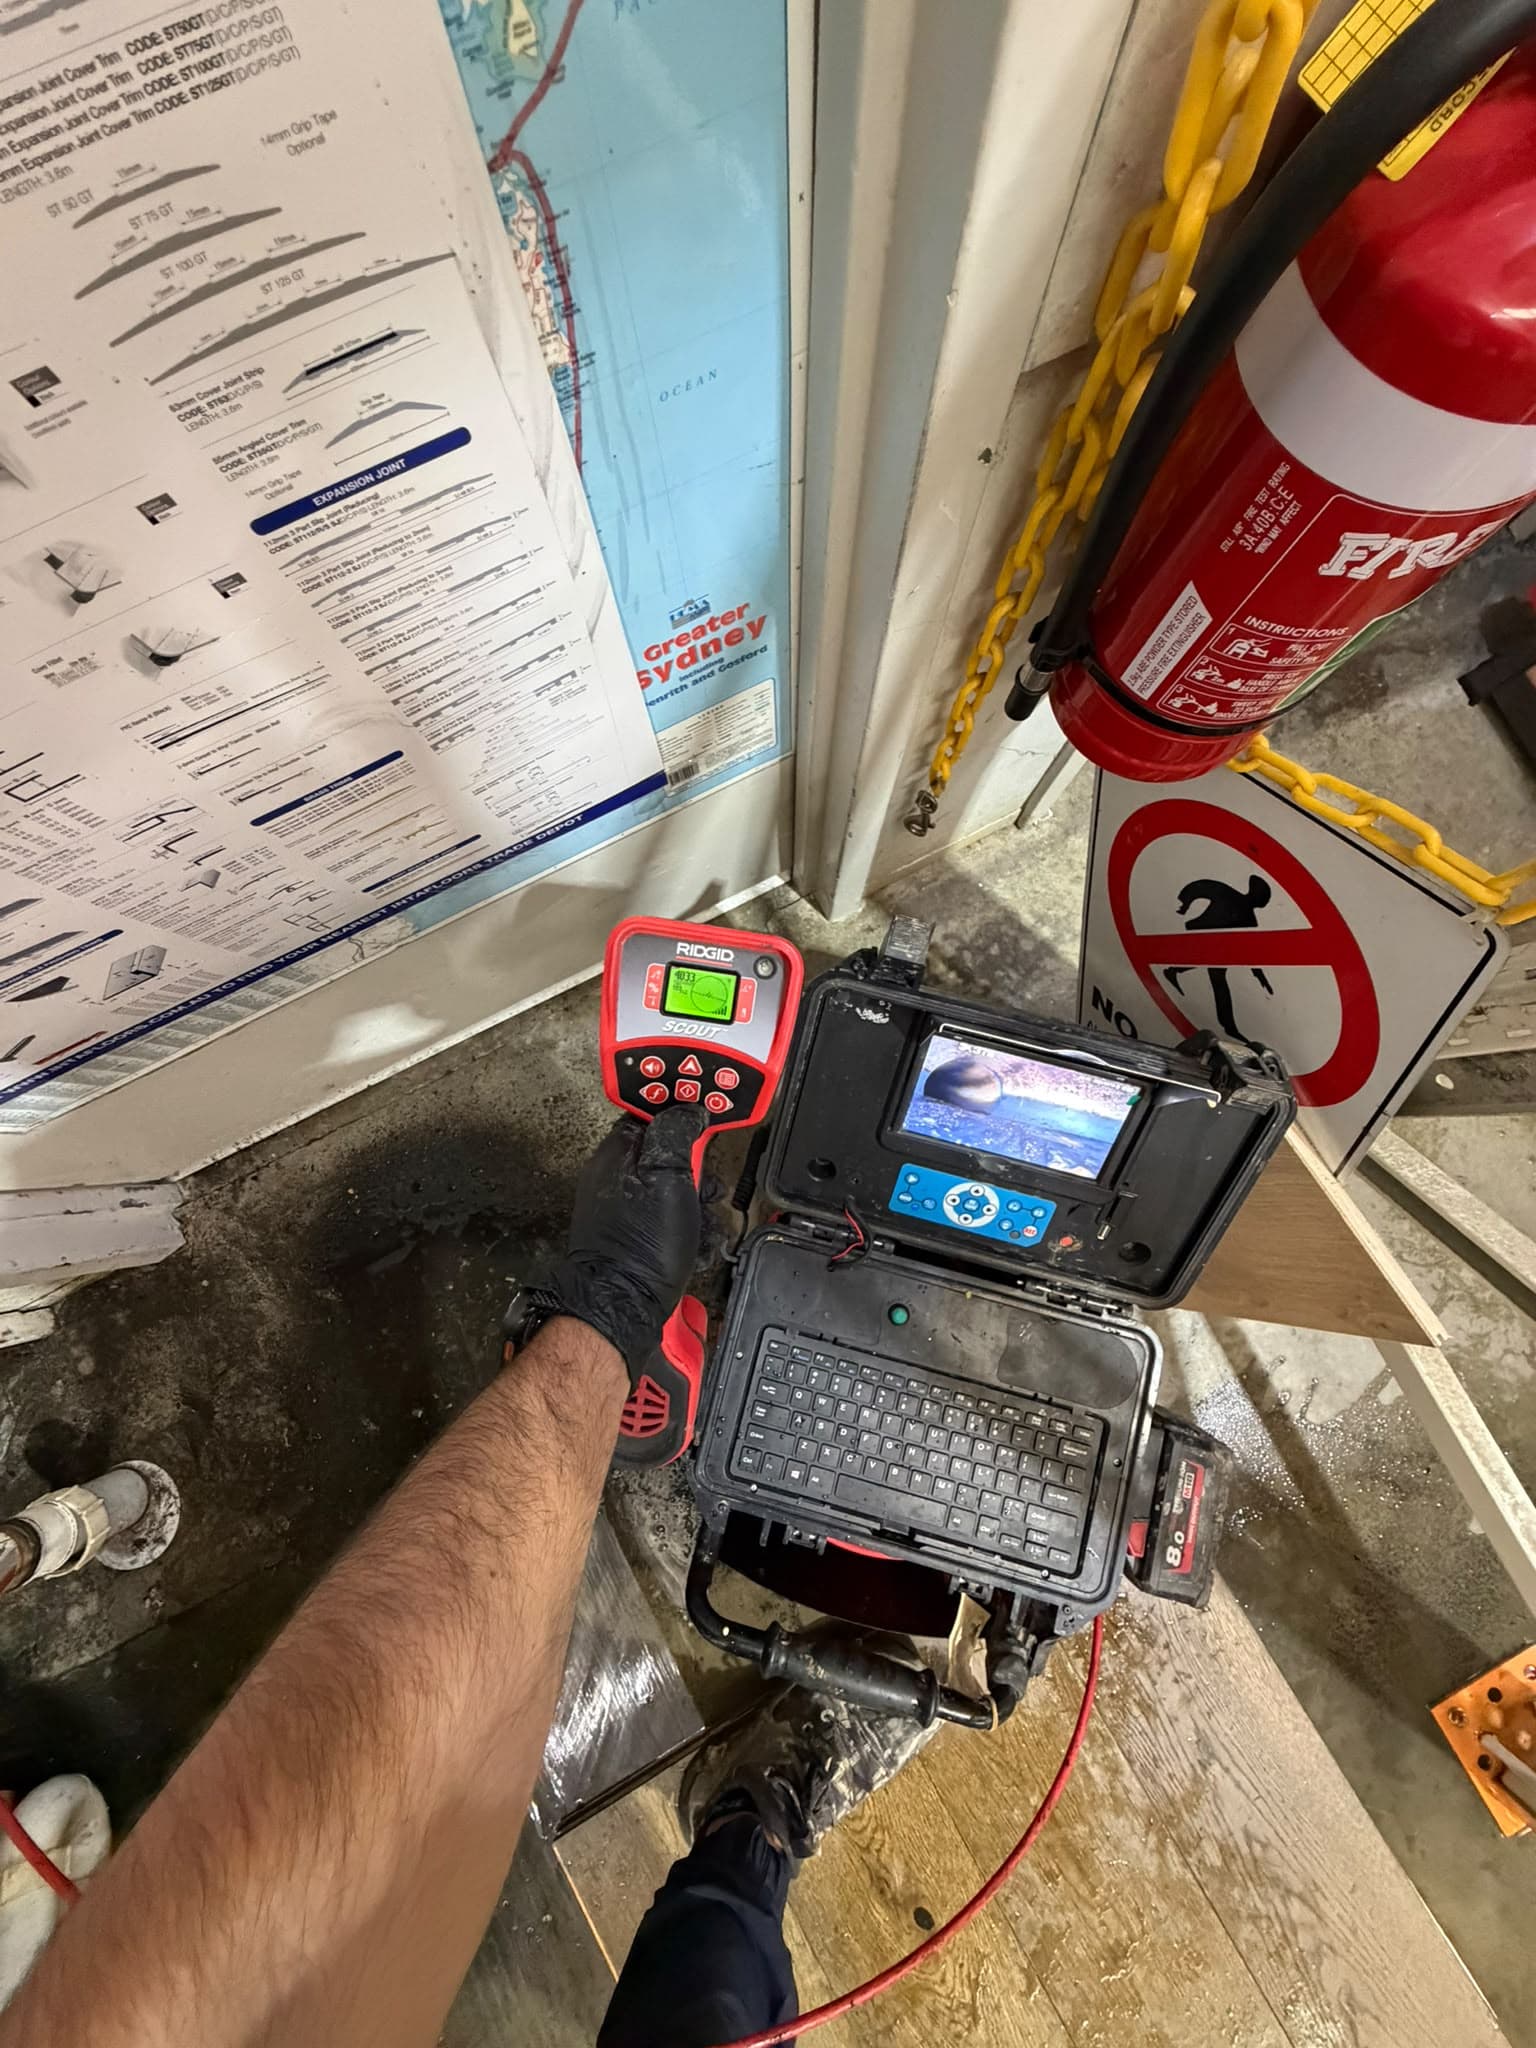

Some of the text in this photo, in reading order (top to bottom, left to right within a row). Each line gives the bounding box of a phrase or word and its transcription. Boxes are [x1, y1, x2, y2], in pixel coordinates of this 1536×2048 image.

[38, 73, 65, 94] Joint
[62, 60, 97, 82] Cover
[95, 50, 122, 68] Trim
[125, 31, 163, 56] CODE:
[51, 92, 79, 113] Joint
[76, 79, 109, 101] Cover
[105, 70, 134, 88] Trim
[137, 51, 175, 76] CODE:
[7, 124, 64, 153] Expansion
[64, 111, 91, 131] Joint
[88, 99, 121, 119] Cover
[119, 89, 145, 106] Trim
[143, 73, 181, 96] CODE:
[312, 109, 338, 126] Tape
[1430, 77, 1482, 132] CORD
[20, 142, 77, 171] Expansion
[77, 128, 103, 149] Joint
[100, 117, 132, 137] Cover
[130, 107, 156, 124] Trim
[154, 92, 190, 114] CODE:
[286, 132, 326, 157] Optional
[77, 188, 94, 204] GT
[158, 202, 175, 218] GT
[192, 251, 209, 265] GT
[222, 375, 244, 390] Joint
[243, 366, 265, 379] Strip
[658, 368, 719, 403] OCEAN
[176, 406, 207, 423] CODE:
[265, 427, 289, 441] Cover
[264, 483, 294, 501] Optional
[311, 457, 408, 508] EXPANSION JOINT
[642, 601, 751, 662] Greater
[1144, 635, 1168, 663] POWDER
[1162, 620, 1178, 640] TYPE
[1173, 595, 1199, 625] STORED
[1243, 615, 1350, 638] INSTRUCTIONS
[1137, 611, 1207, 695] PRESSURE FIRE EXTINGUISHER
[645, 644, 768, 707] enrith and Gosford
[210, 982, 237, 997] TO
[238, 962, 275, 982] FIND
[275, 941, 320, 963] YOUR
[320, 908, 389, 943] NEAREST
[392, 861, 484, 909] INTAFLOORS
[484, 838, 535, 865] TRADE
[535, 813, 584, 840] DEPOT
[675, 941, 735, 963] RIDGID
[661, 1019, 723, 1039] SCOUT
[1091, 984, 1139, 1041] NO
[1165, 1530, 1186, 1568] 8.0
